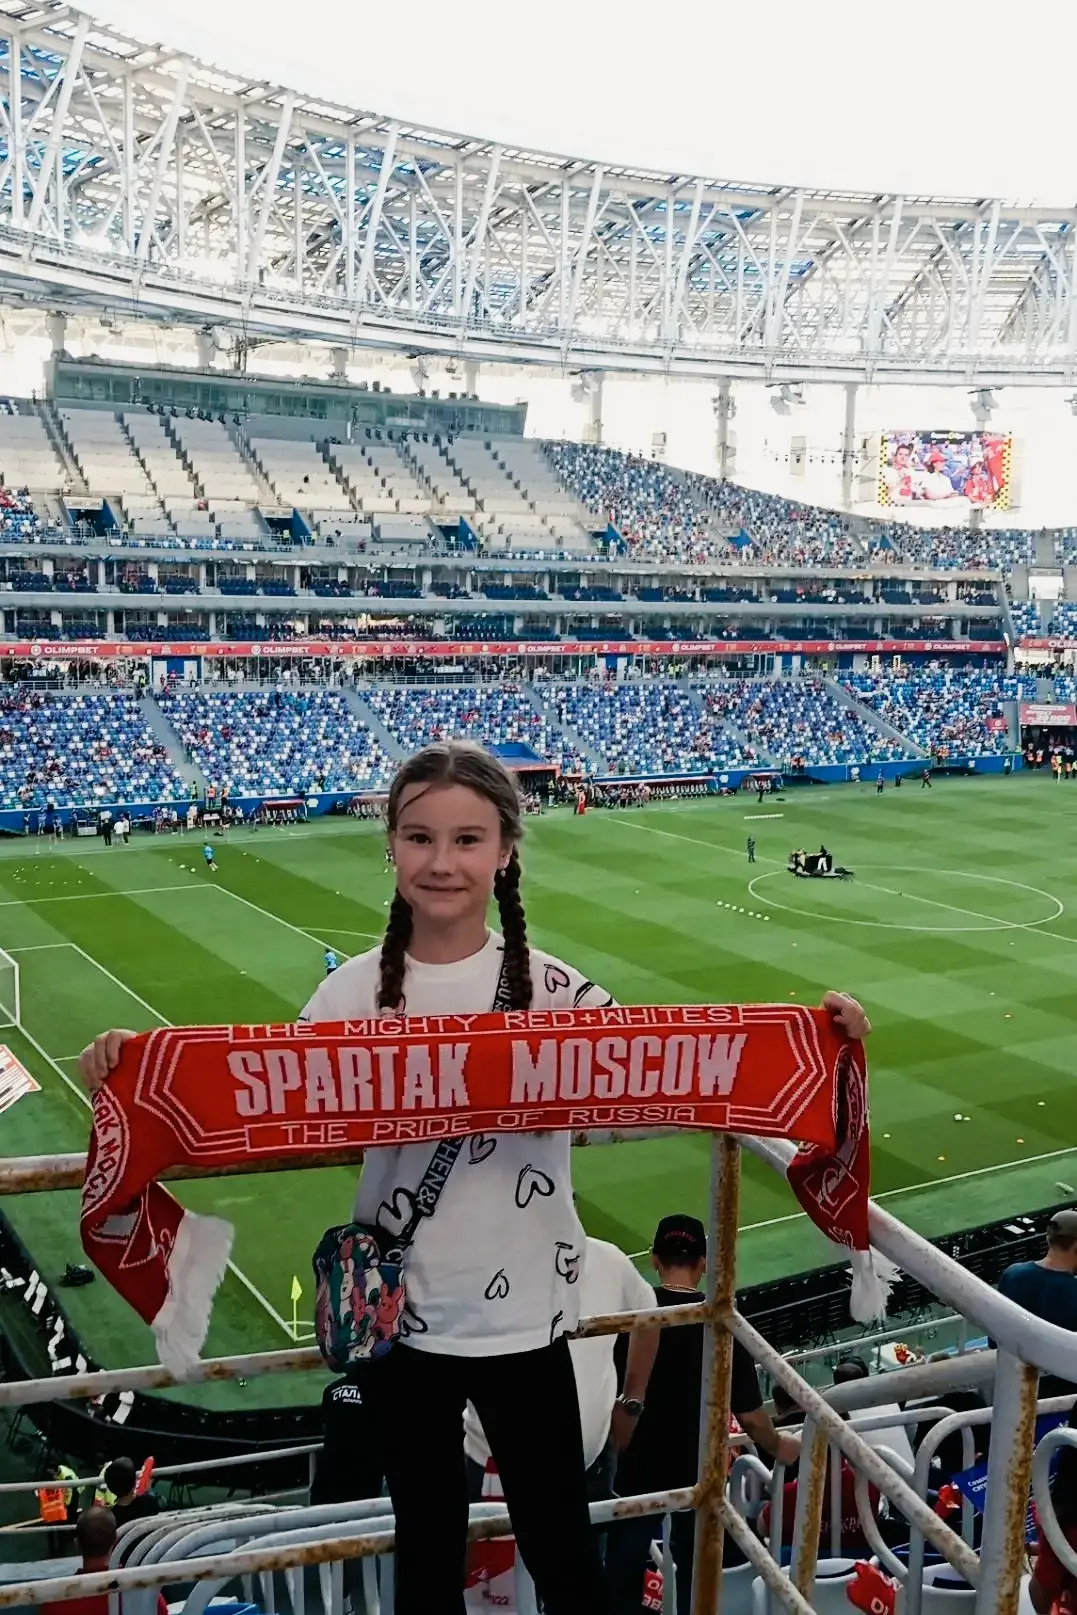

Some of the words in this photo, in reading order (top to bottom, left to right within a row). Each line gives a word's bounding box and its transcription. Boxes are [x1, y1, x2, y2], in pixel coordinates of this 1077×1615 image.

[241, 1021, 317, 1039] THE
[343, 1015, 479, 1036] MIGHTY
[504, 1006, 733, 1029] RED+WHITES
[226, 1042, 471, 1118] SPARTAK
[510, 1033, 748, 1103] MOSCOW
[280, 1122, 349, 1145] THE
[372, 1115, 472, 1140] PRIDE
[496, 1111, 544, 1128] OF
[567, 1106, 697, 1124] RUSSIA
